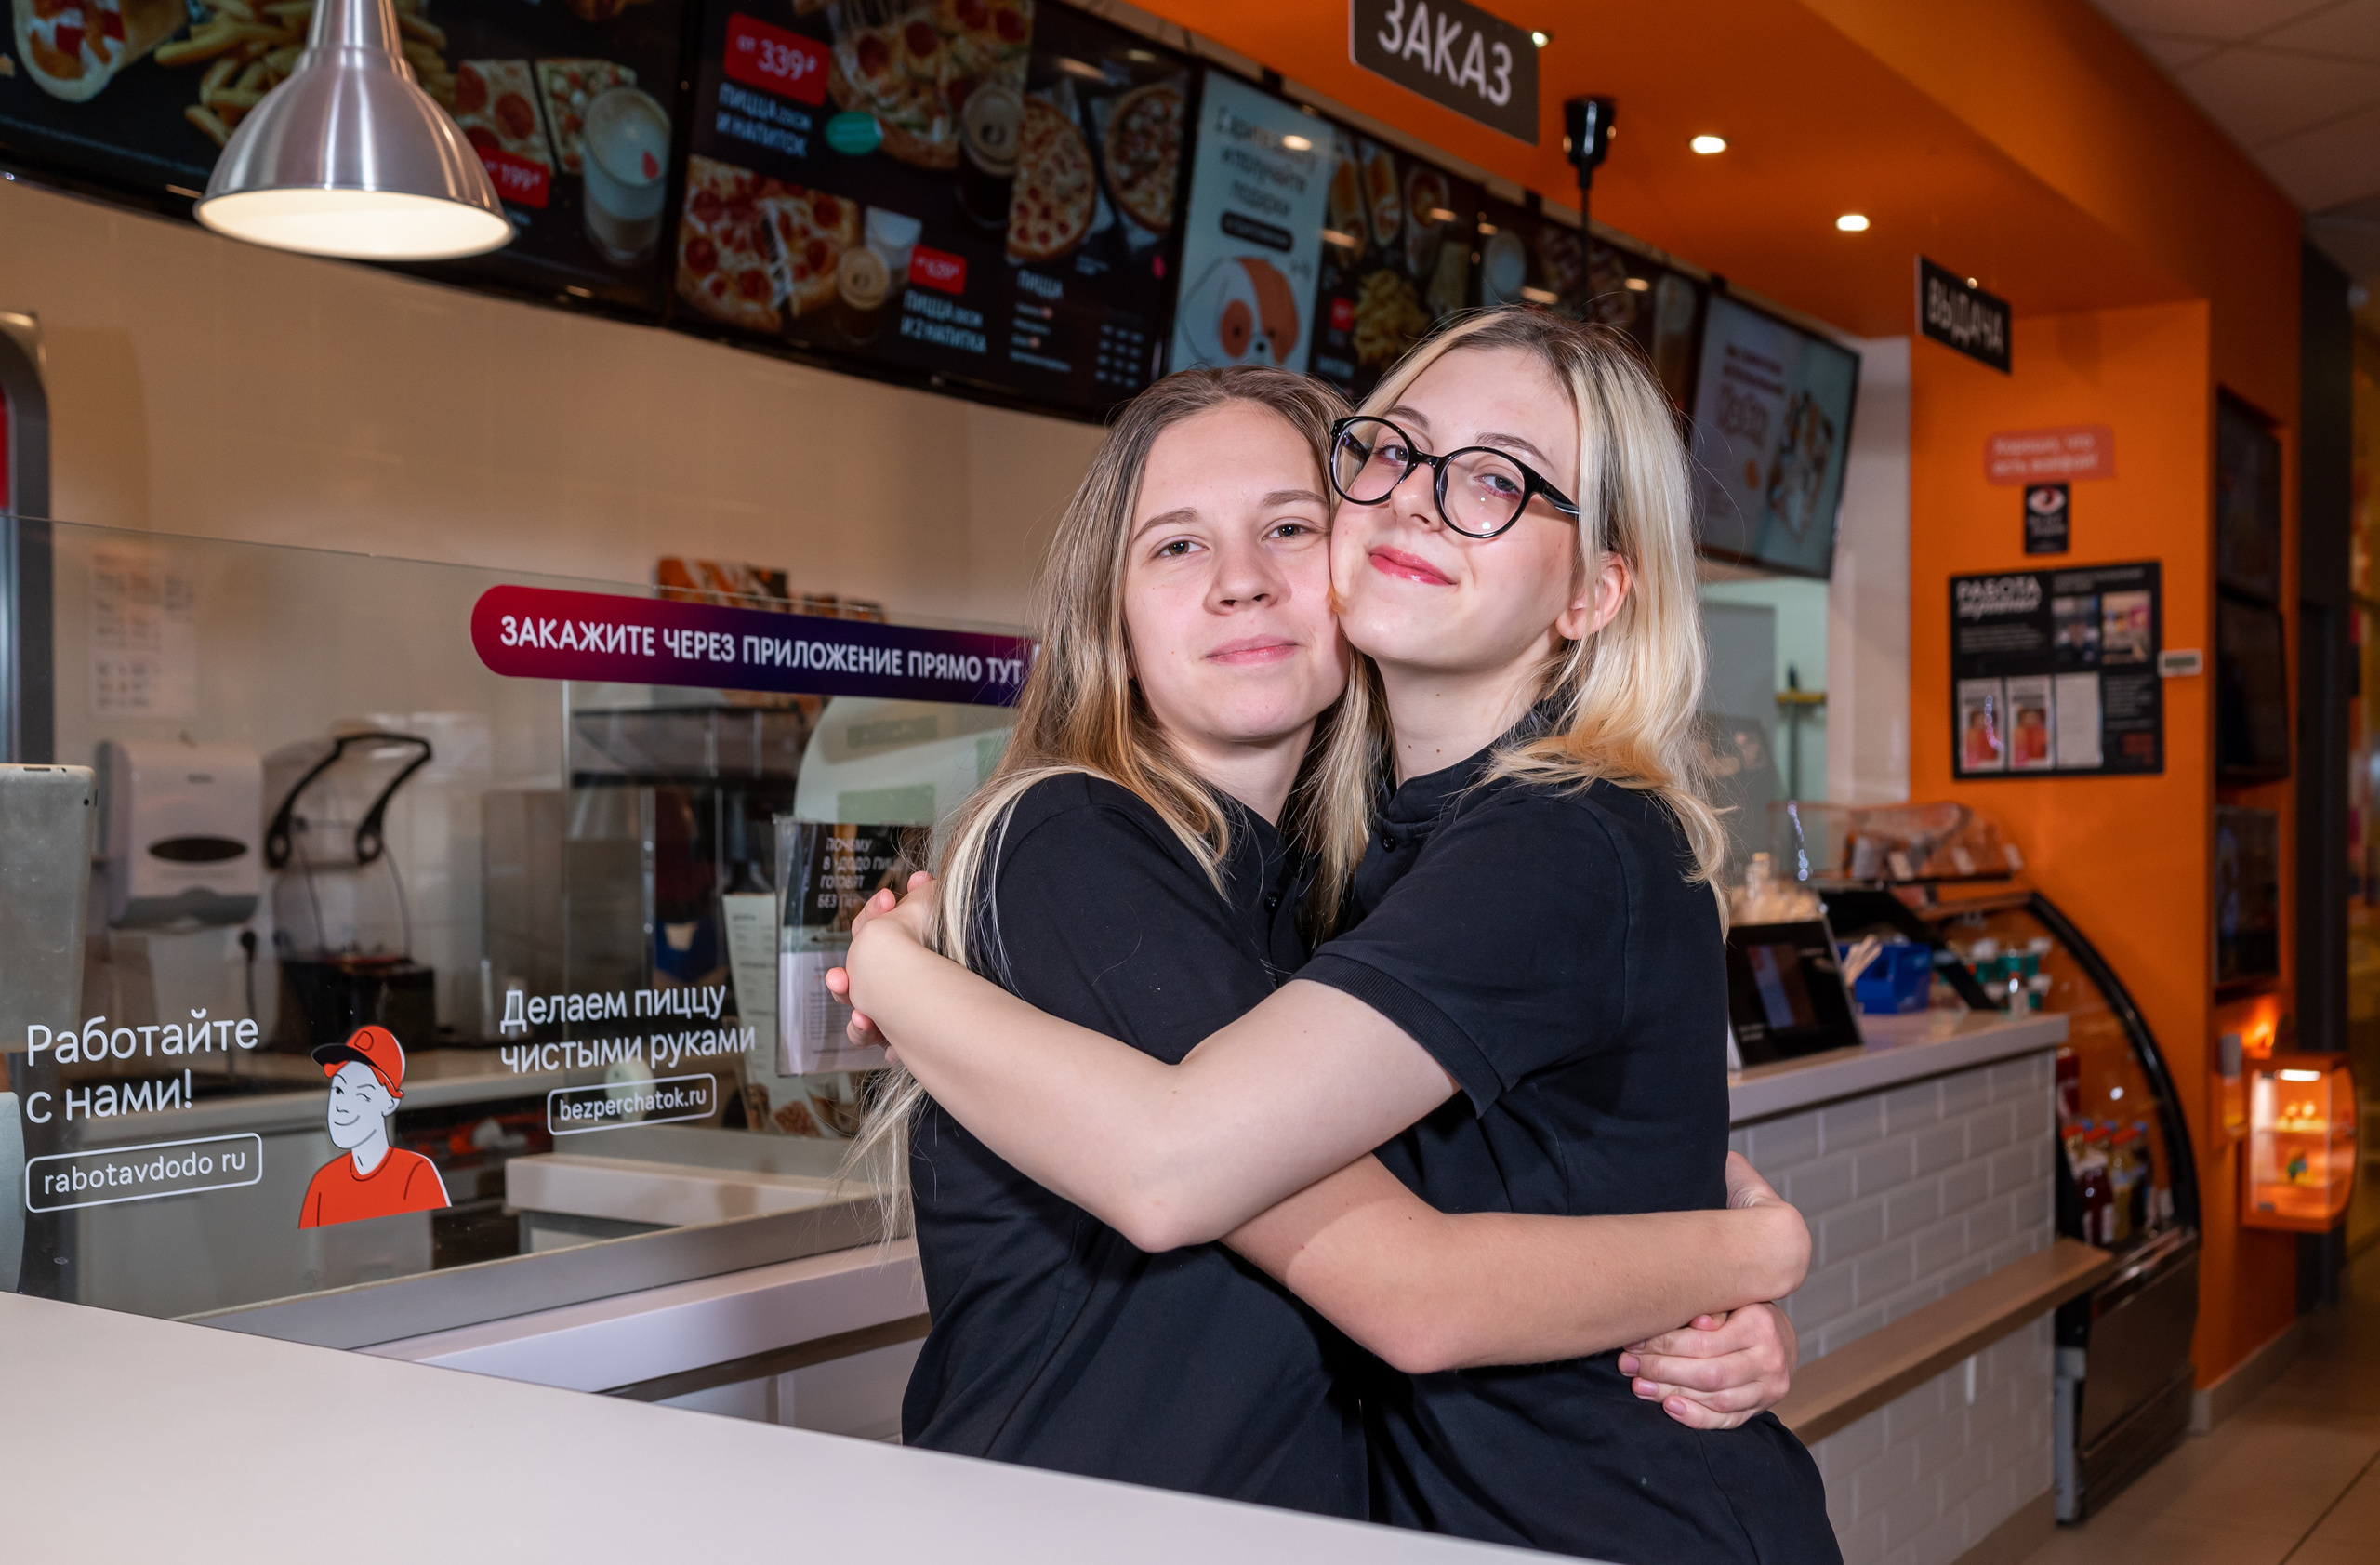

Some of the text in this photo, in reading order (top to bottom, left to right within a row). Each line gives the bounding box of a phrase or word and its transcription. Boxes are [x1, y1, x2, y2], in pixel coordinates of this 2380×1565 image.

[1377, 0, 1513, 106] ЗАКАЗ
[1927, 277, 2005, 353] ВЫДАЧА
[1957, 577, 2042, 602] РАБОТА
[499, 614, 1023, 685] ЗАКАЖИТЕ ЧЕРЕЗ ПРИЛОЖЕНИЕ ПРЯМО ТУТ
[822, 855, 832, 871] В
[825, 837, 872, 853] ПОЧЕМУ
[817, 894, 838, 908] БЕЗ
[820, 875, 866, 890] ГОТОВЯТ
[499, 984, 727, 1034] Делаем пиццу
[27, 1007, 259, 1068] Работайте
[500, 1025, 757, 1074] чистыми руками
[26, 1068, 193, 1124] с нами!
[559, 1086, 707, 1122] bezperchatok.ru
[44, 1151, 214, 1195] rabotavdodo
